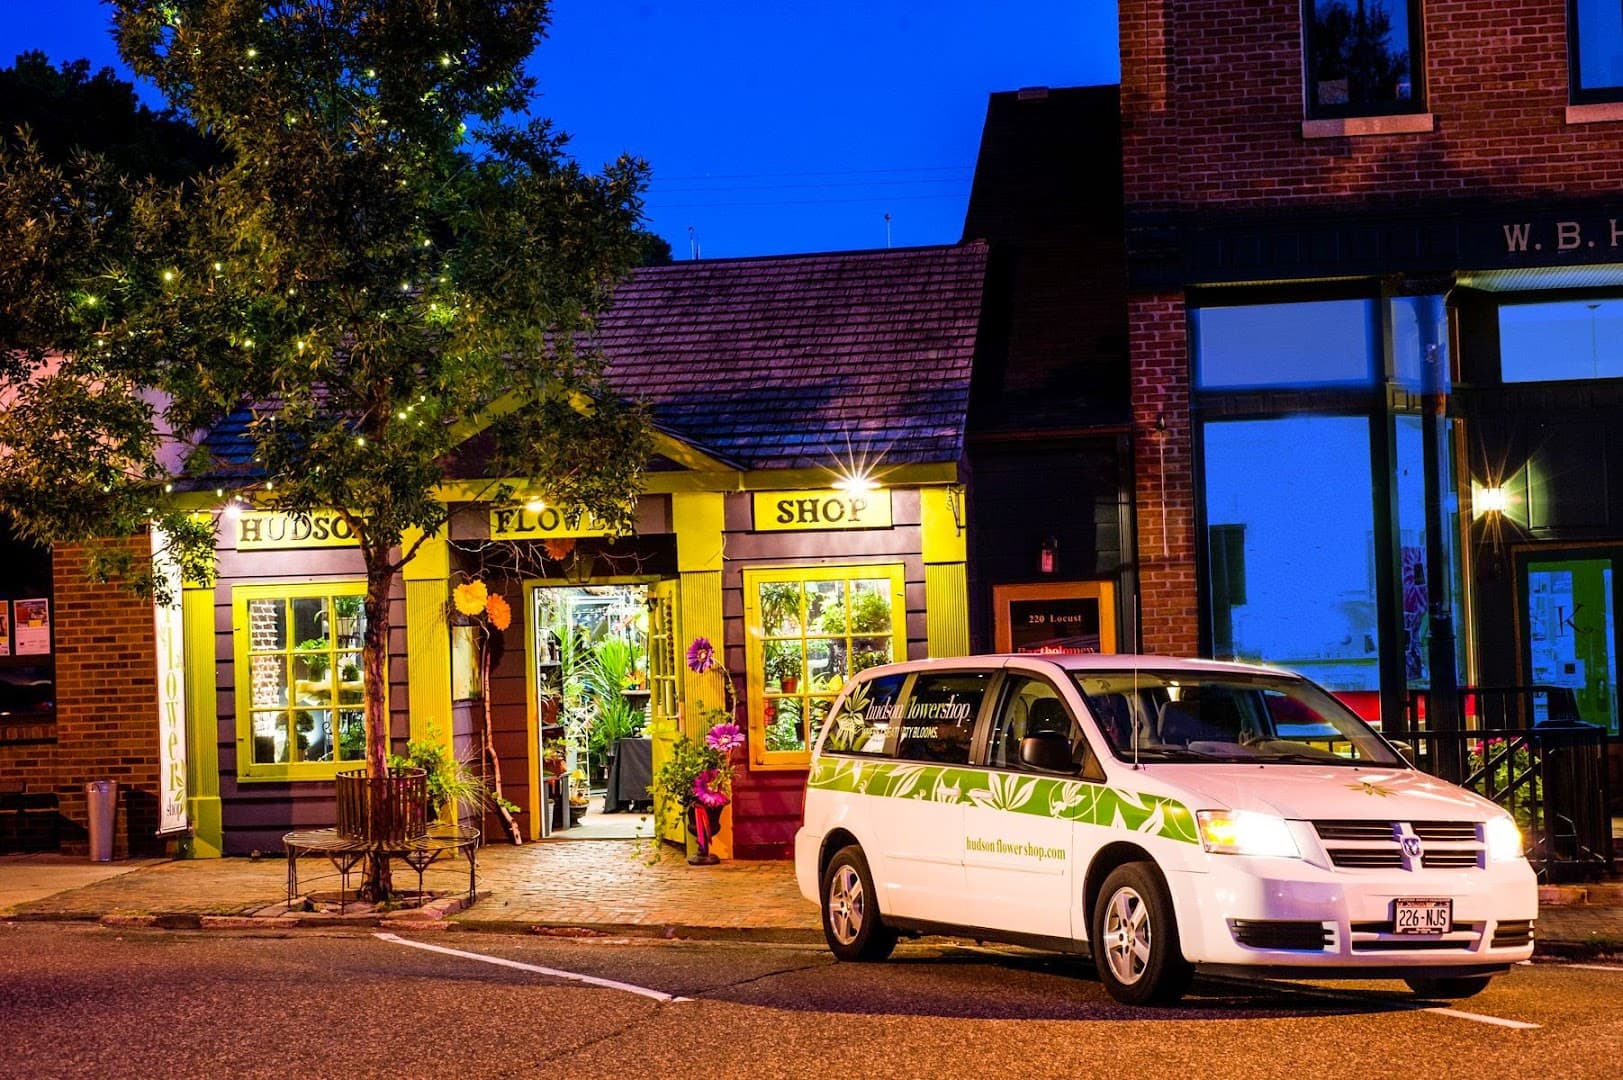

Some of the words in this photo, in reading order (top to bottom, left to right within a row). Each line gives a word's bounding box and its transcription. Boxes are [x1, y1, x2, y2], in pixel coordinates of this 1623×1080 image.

[1503, 223, 1541, 252] W.
[1556, 221, 1594, 250] B.
[776, 498, 868, 524] SHOP
[239, 514, 368, 542] HUDSO
[1029, 614, 1045, 624] 220
[1050, 614, 1082, 623] Locust
[866, 697, 905, 720] hudson
[1400, 909, 1446, 926] 226-NJS
